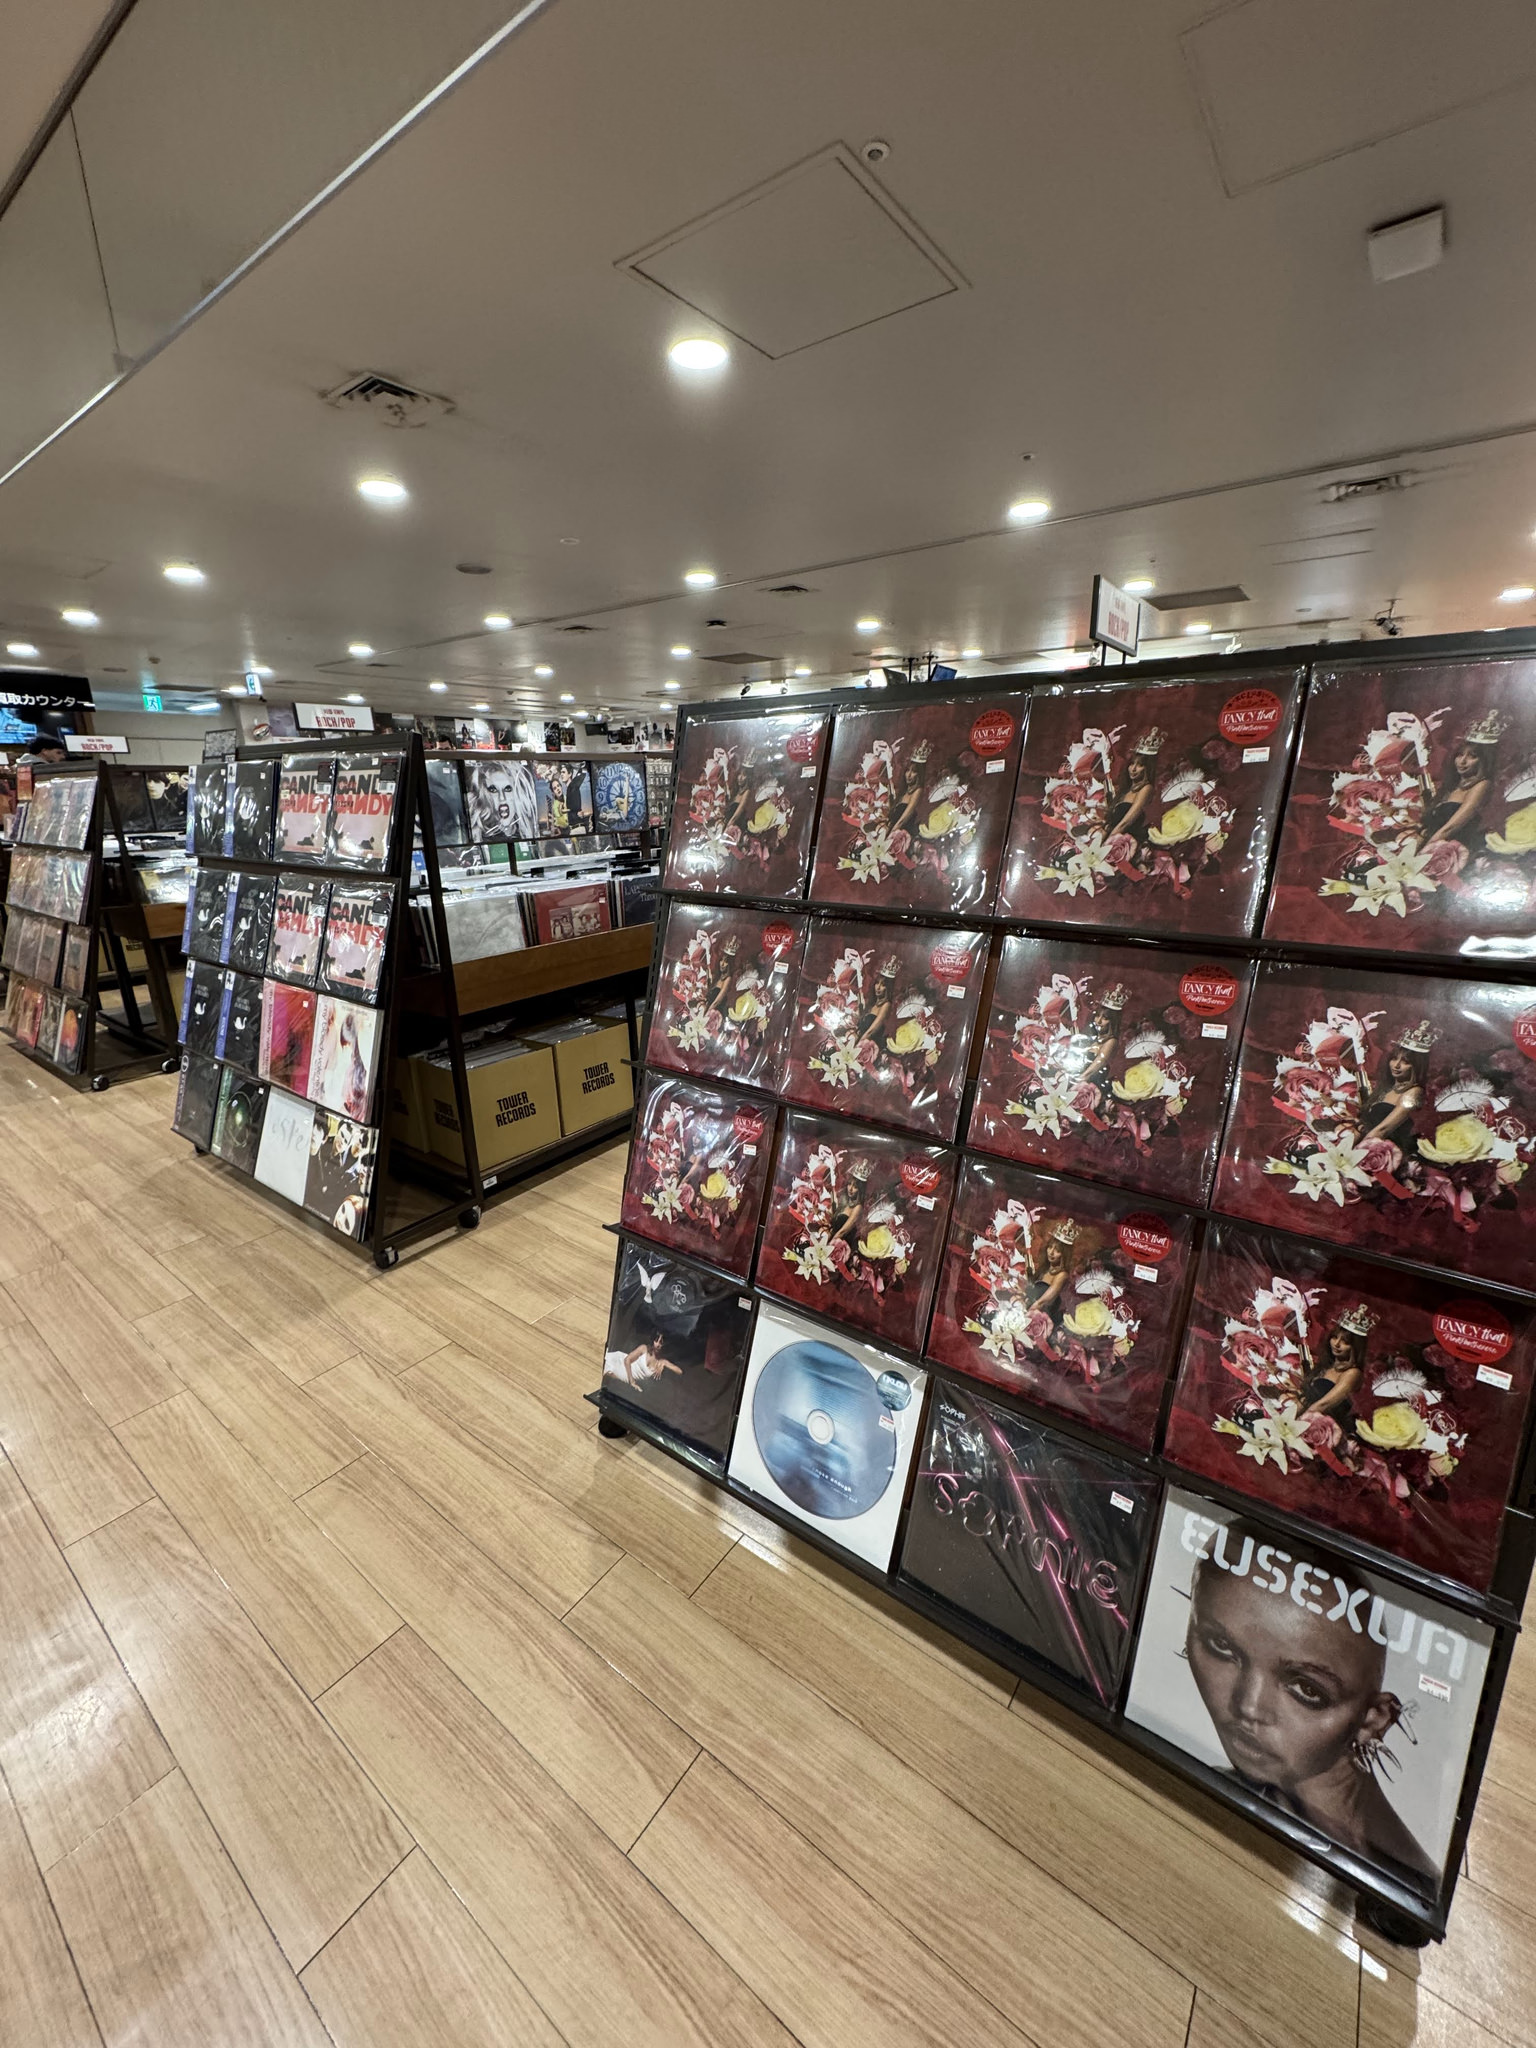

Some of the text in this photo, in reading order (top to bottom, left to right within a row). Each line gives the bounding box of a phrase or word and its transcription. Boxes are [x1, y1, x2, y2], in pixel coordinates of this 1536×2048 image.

[1223, 709, 1276, 724] FANCY that
[1183, 982, 1233, 996] FANCY that
[583, 1062, 610, 1081] TOWER
[582, 1072, 616, 1095] RECORDS
[496, 1091, 529, 1112] TOWER
[495, 1102, 537, 1128] RECORDS
[1122, 1227, 1168, 1246] FANCY that
[1440, 1318, 1506, 1344] FANCY that
[1181, 1511, 1468, 1681] EUSEXUA
